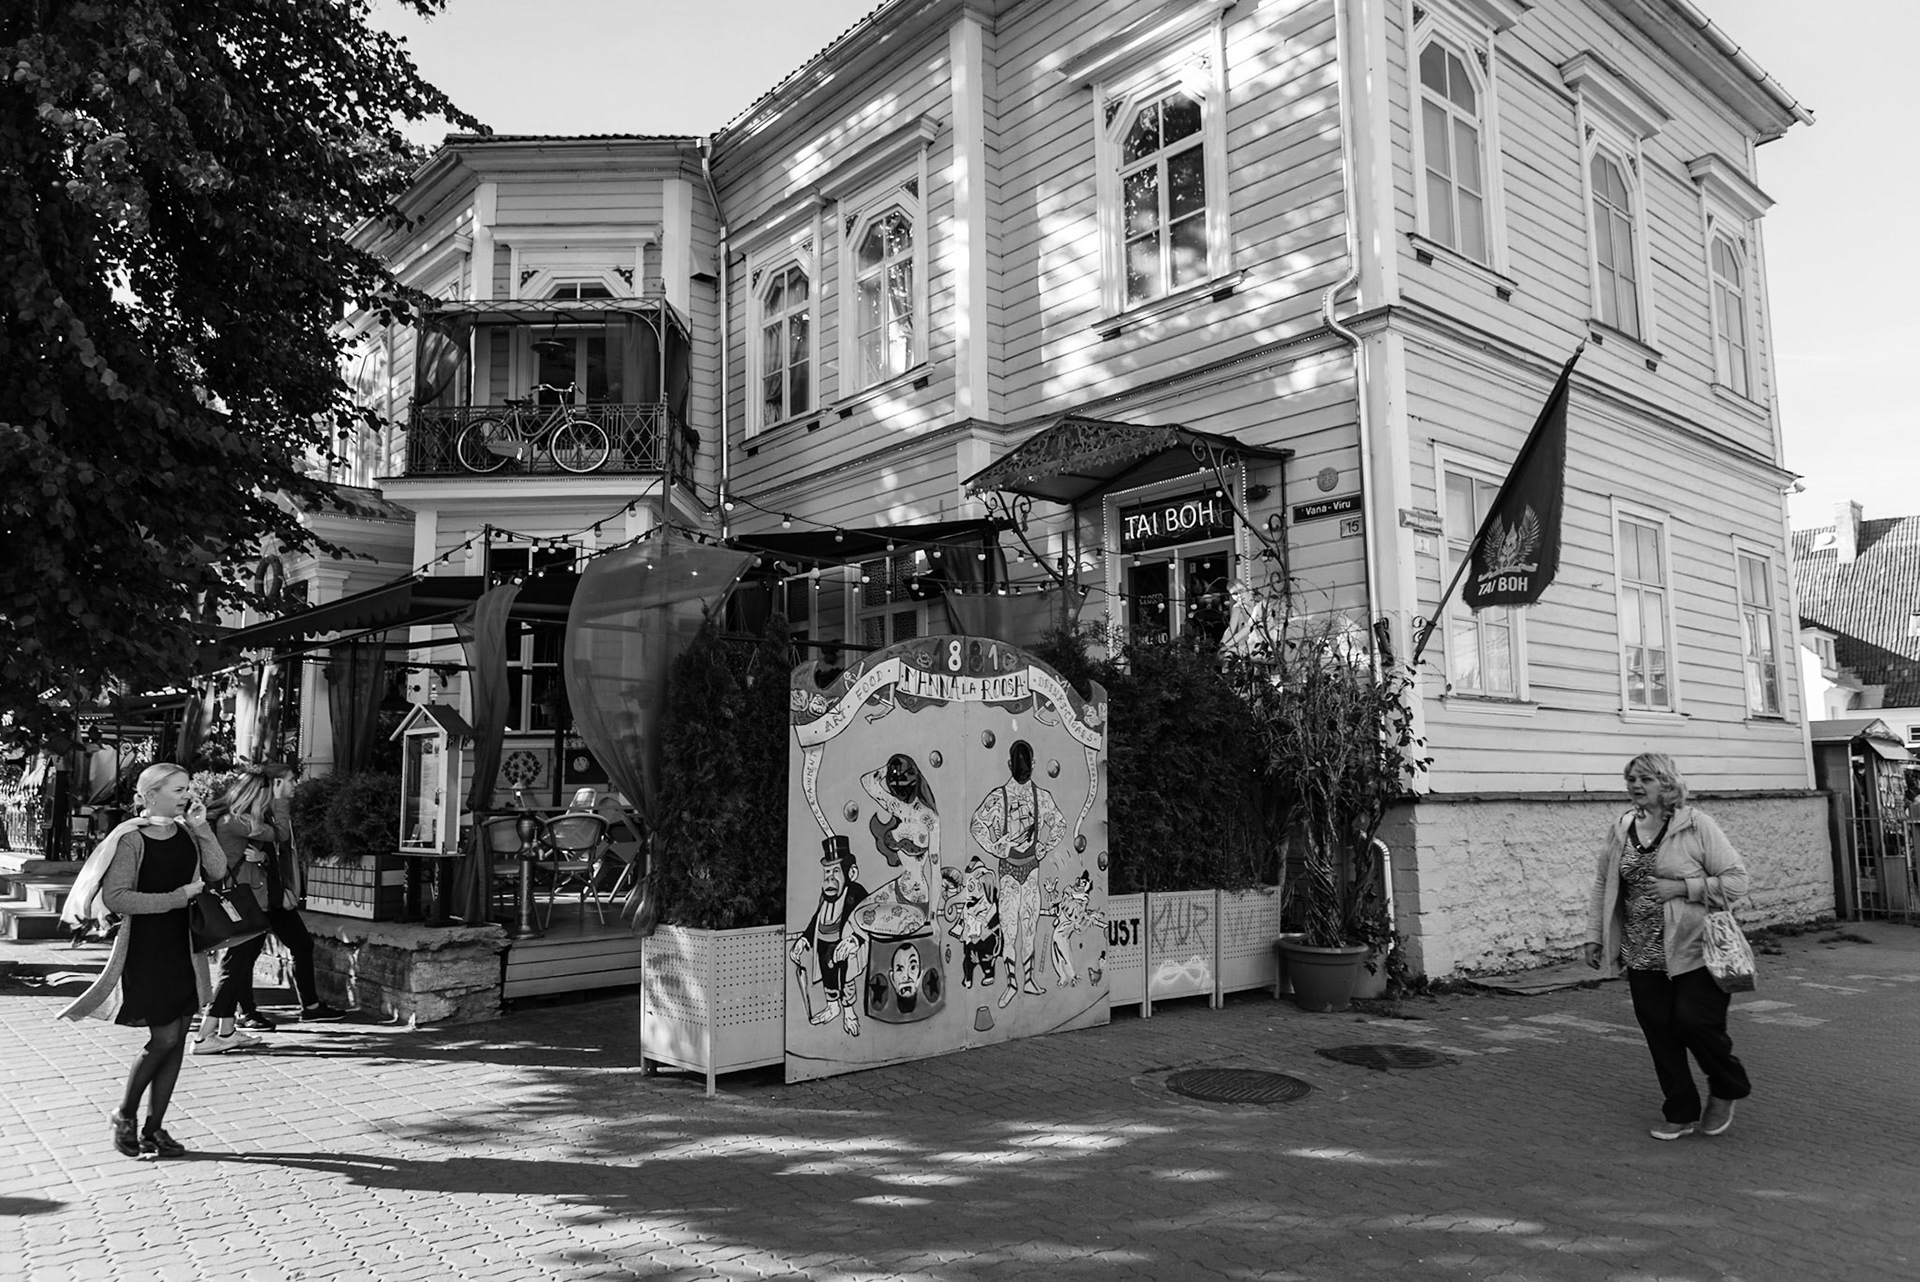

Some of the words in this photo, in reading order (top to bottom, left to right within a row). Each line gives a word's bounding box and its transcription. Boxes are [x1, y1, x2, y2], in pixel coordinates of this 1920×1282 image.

[1124, 512, 1158, 540] TAI
[1165, 500, 1214, 531] BOH
[1346, 520, 1360, 533] 15
[1478, 580, 1497, 596] TAI
[1497, 576, 1529, 592] BOH
[933, 639, 998, 672] 1881
[901, 665, 960, 700] MANNA
[961, 682, 976, 695] LA
[981, 675, 1027, 700] ROOSA
[1038, 676, 1068, 711] DRINKS
[824, 707, 847, 733] ART
[855, 670, 883, 700] FOOD
[1150, 899, 1208, 953] KAUR
